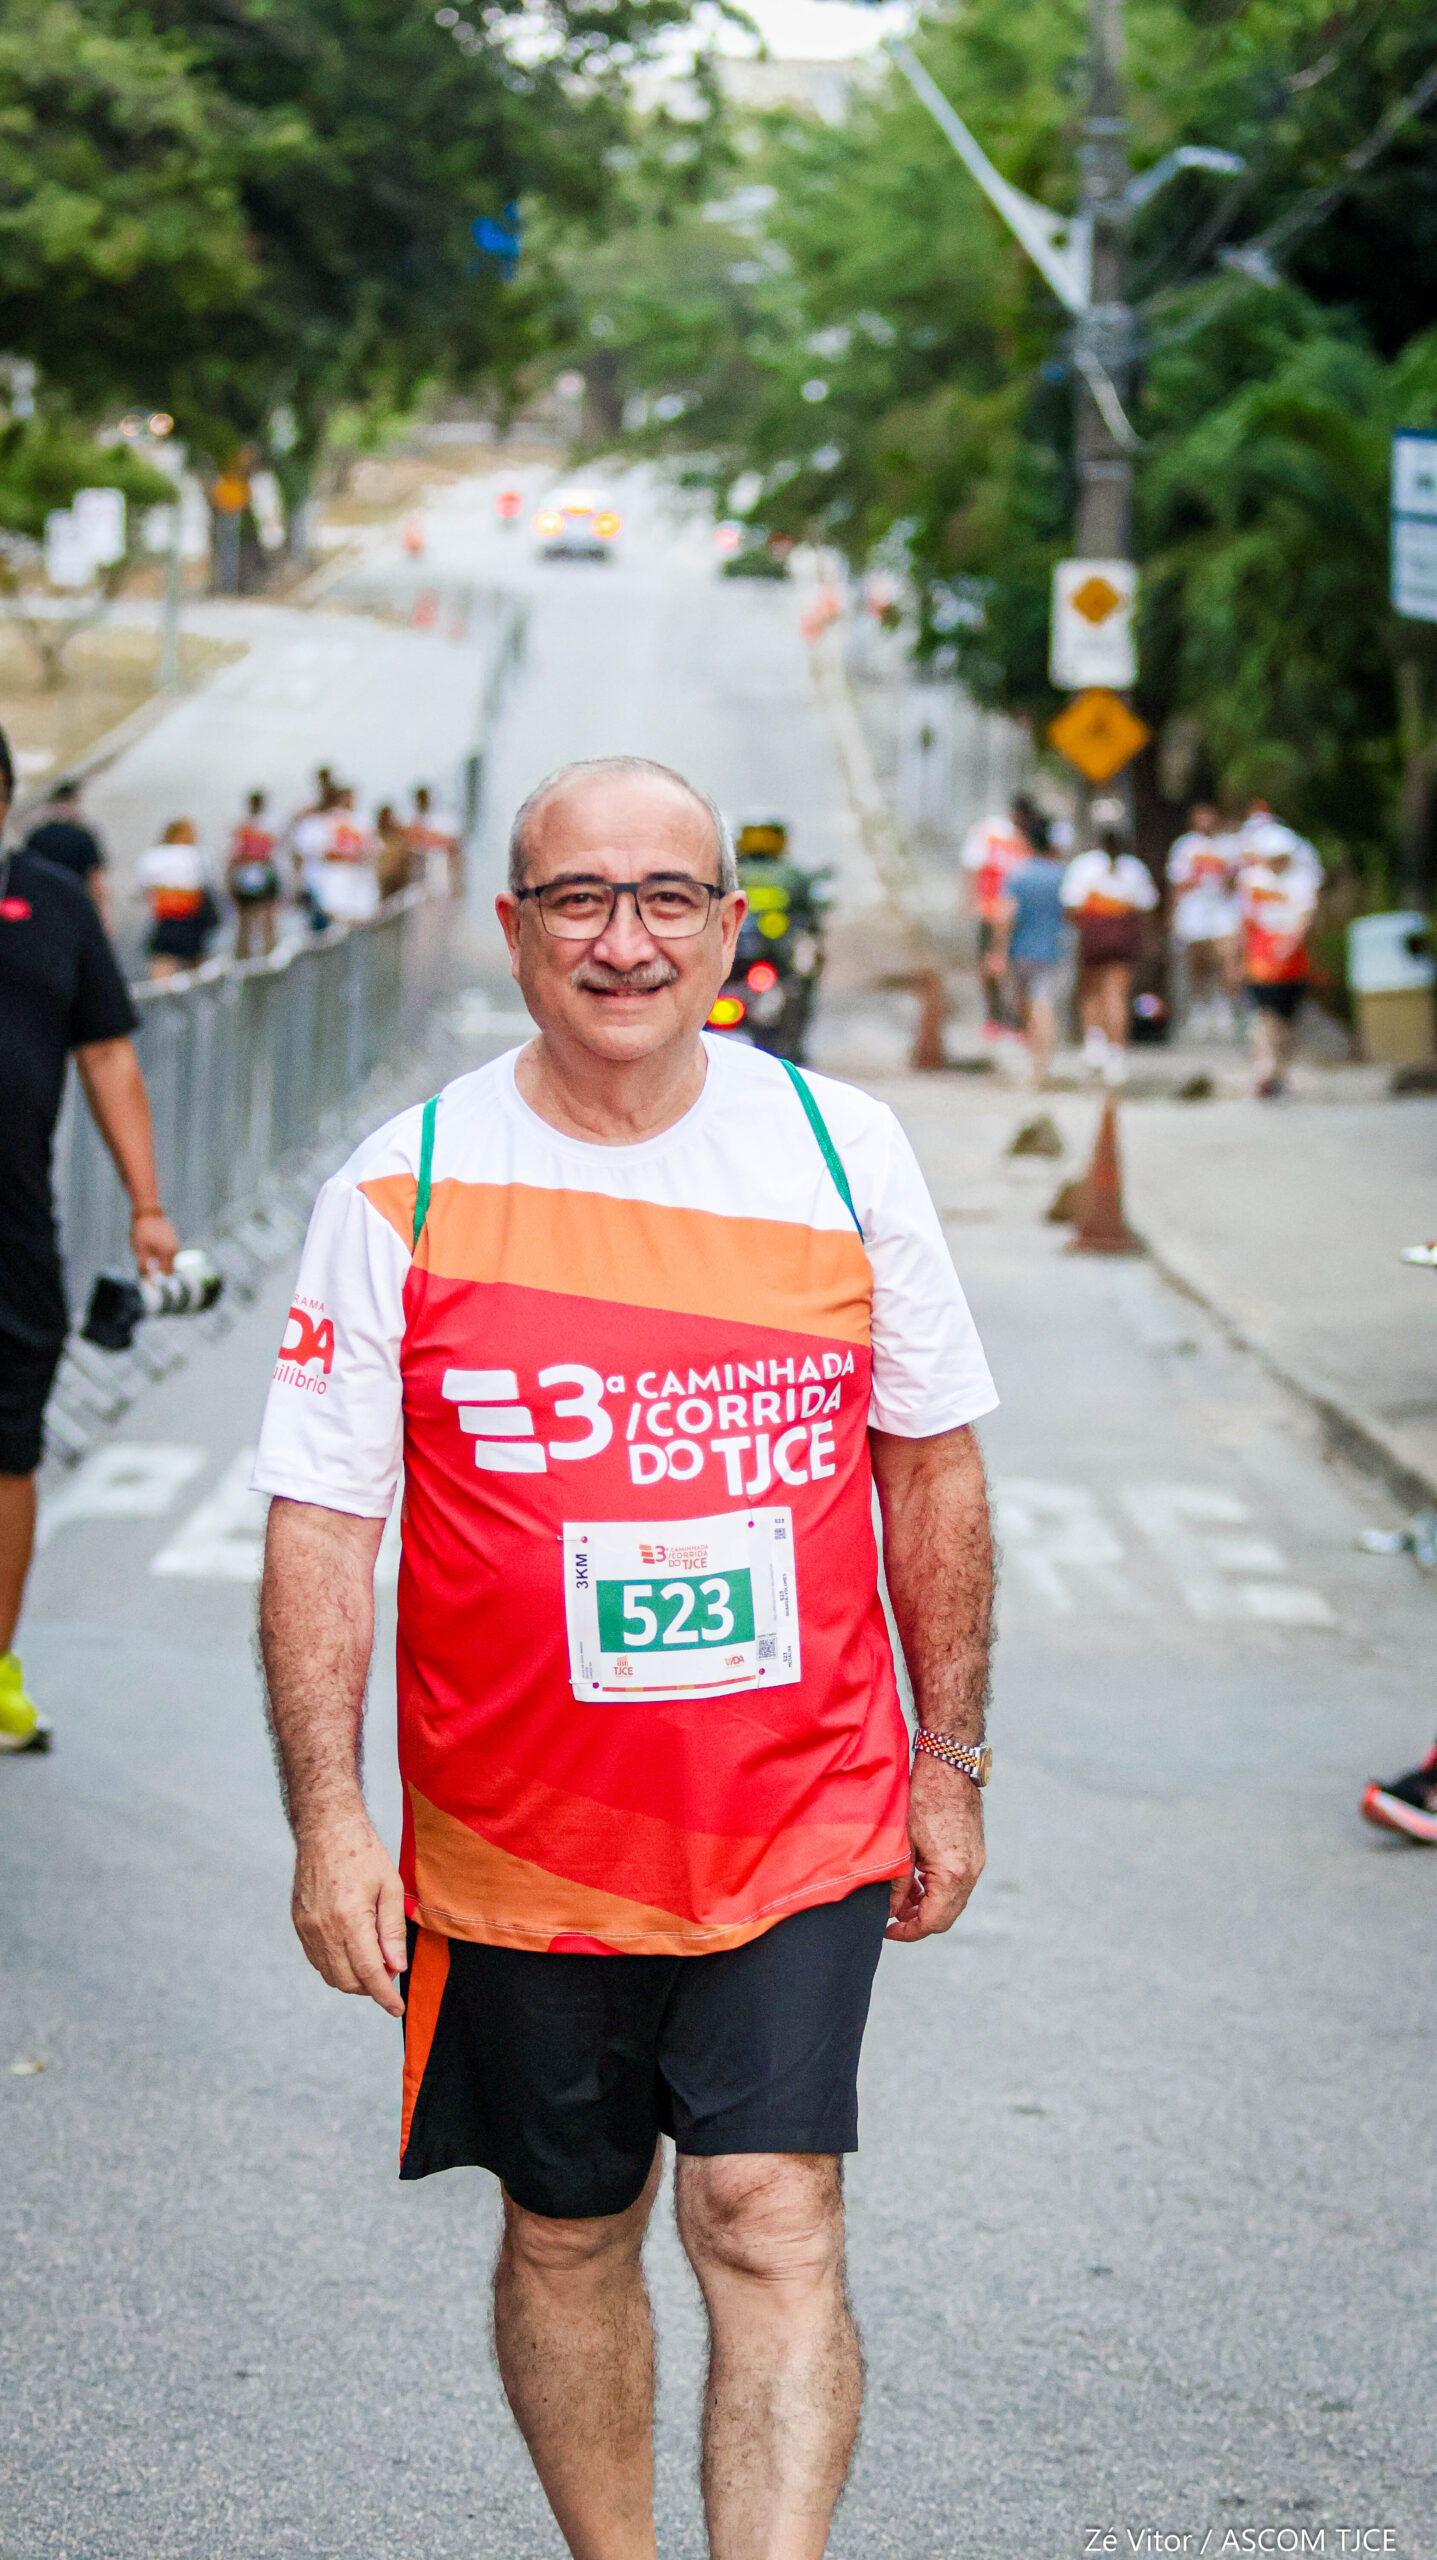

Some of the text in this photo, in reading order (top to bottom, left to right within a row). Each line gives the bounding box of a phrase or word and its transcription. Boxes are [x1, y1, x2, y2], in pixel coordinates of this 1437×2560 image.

[293, 1293, 325, 1312] RAMA
[278, 1306, 335, 1375] DA
[273, 1363, 327, 1395] ilíbrio
[636, 1350, 855, 1399] CAMINHADA
[626, 1382, 841, 1441] /CORRIDA
[628, 1420, 836, 1497] DO TJCE
[668, 1557, 708, 1570] DO TJCE
[670, 1544, 709, 1553] CAMINHADA
[575, 1552, 589, 1590] 3KM
[622, 1577, 735, 1647] 523
[613, 1666, 634, 1676] TJCE
